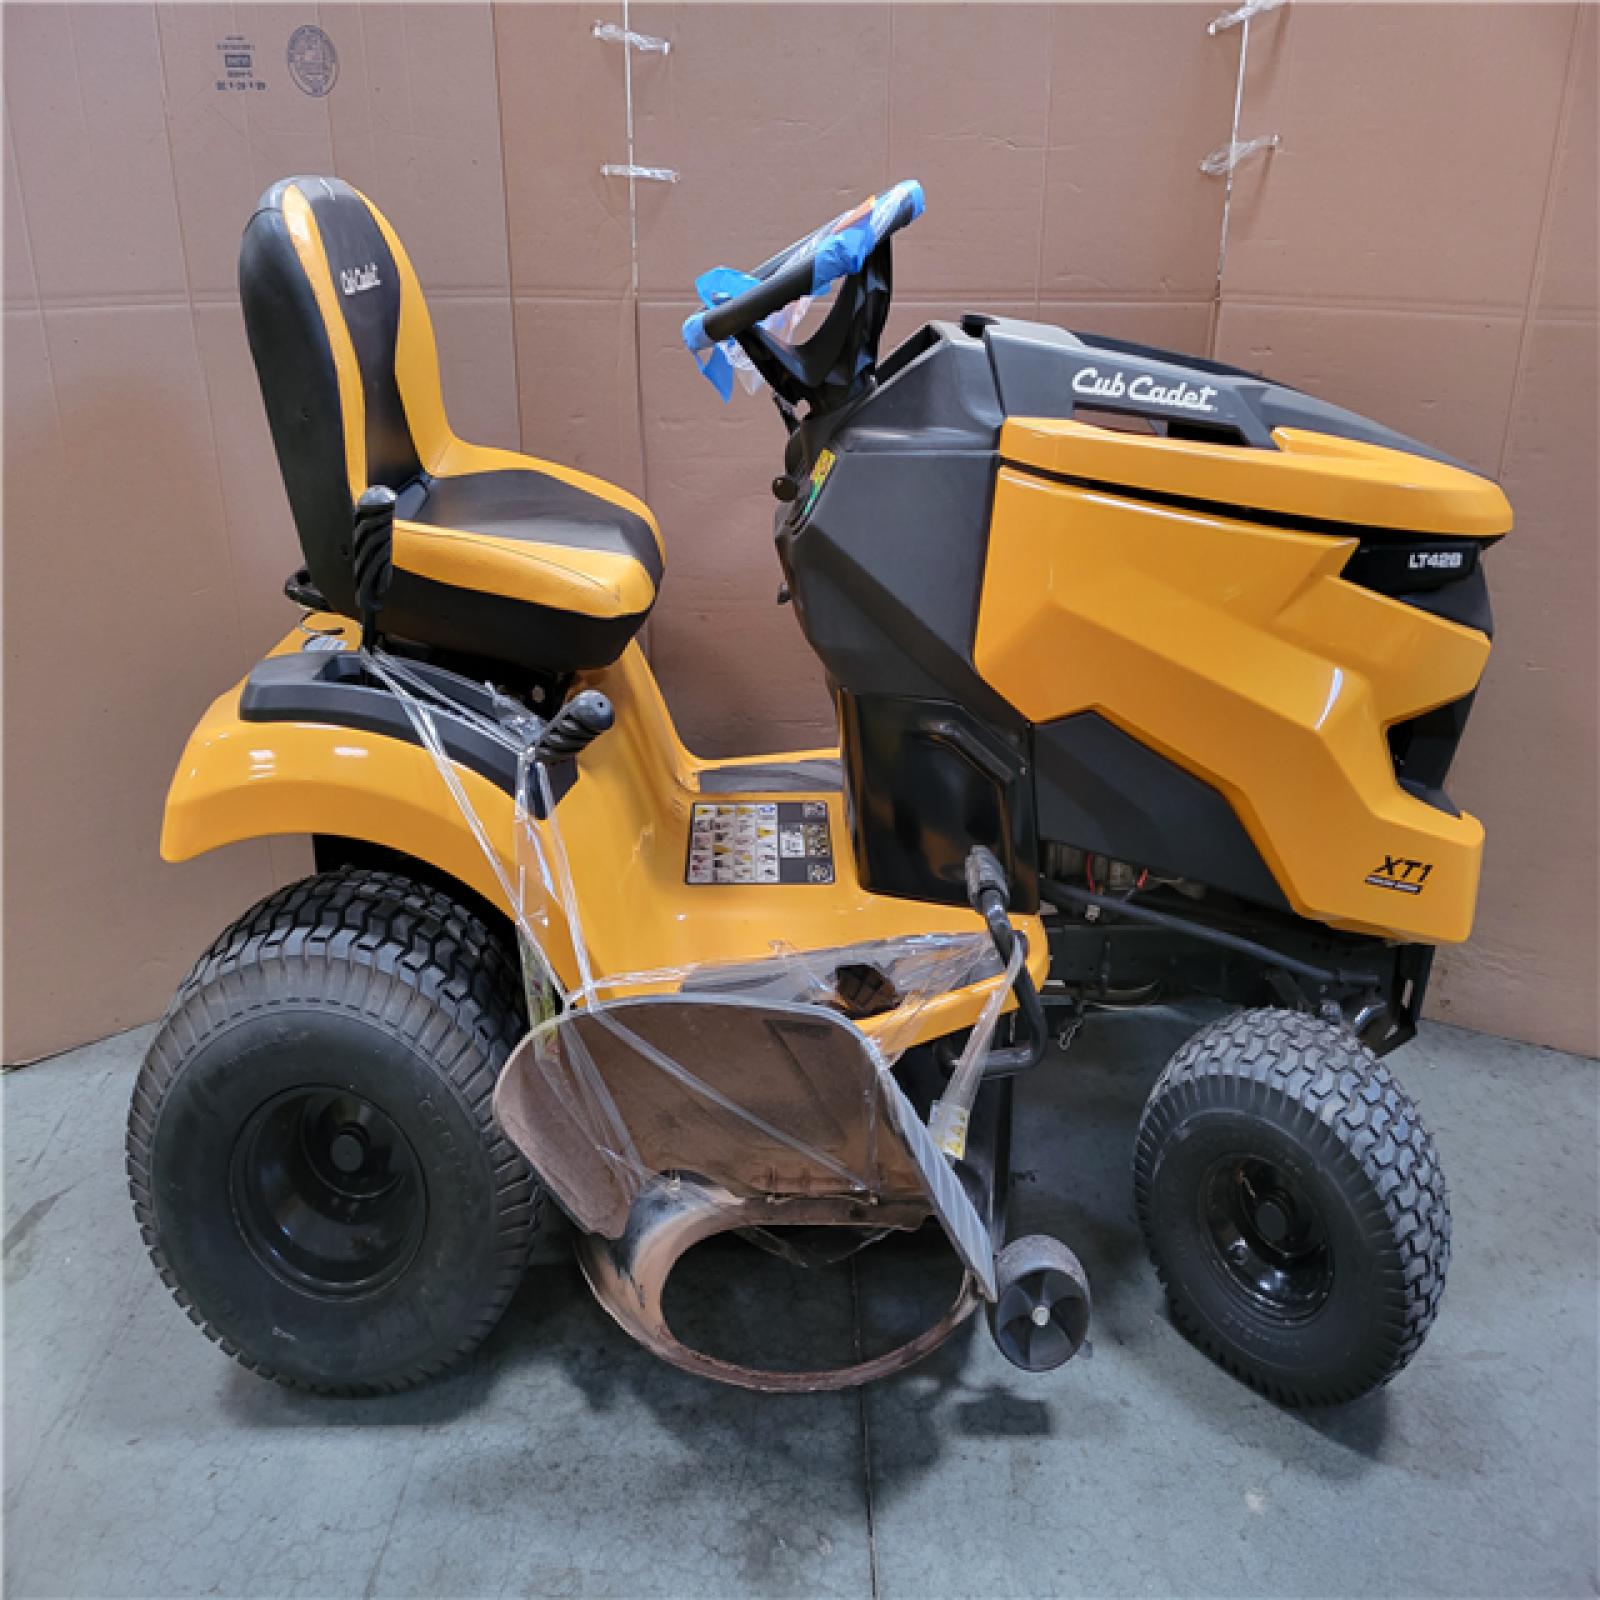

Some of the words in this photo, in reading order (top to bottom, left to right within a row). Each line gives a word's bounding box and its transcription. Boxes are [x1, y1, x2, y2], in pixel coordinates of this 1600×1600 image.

[1072, 367, 1125, 397] Cub
[1128, 375, 1217, 411] Cadet
[1373, 854, 1432, 882] XT1
